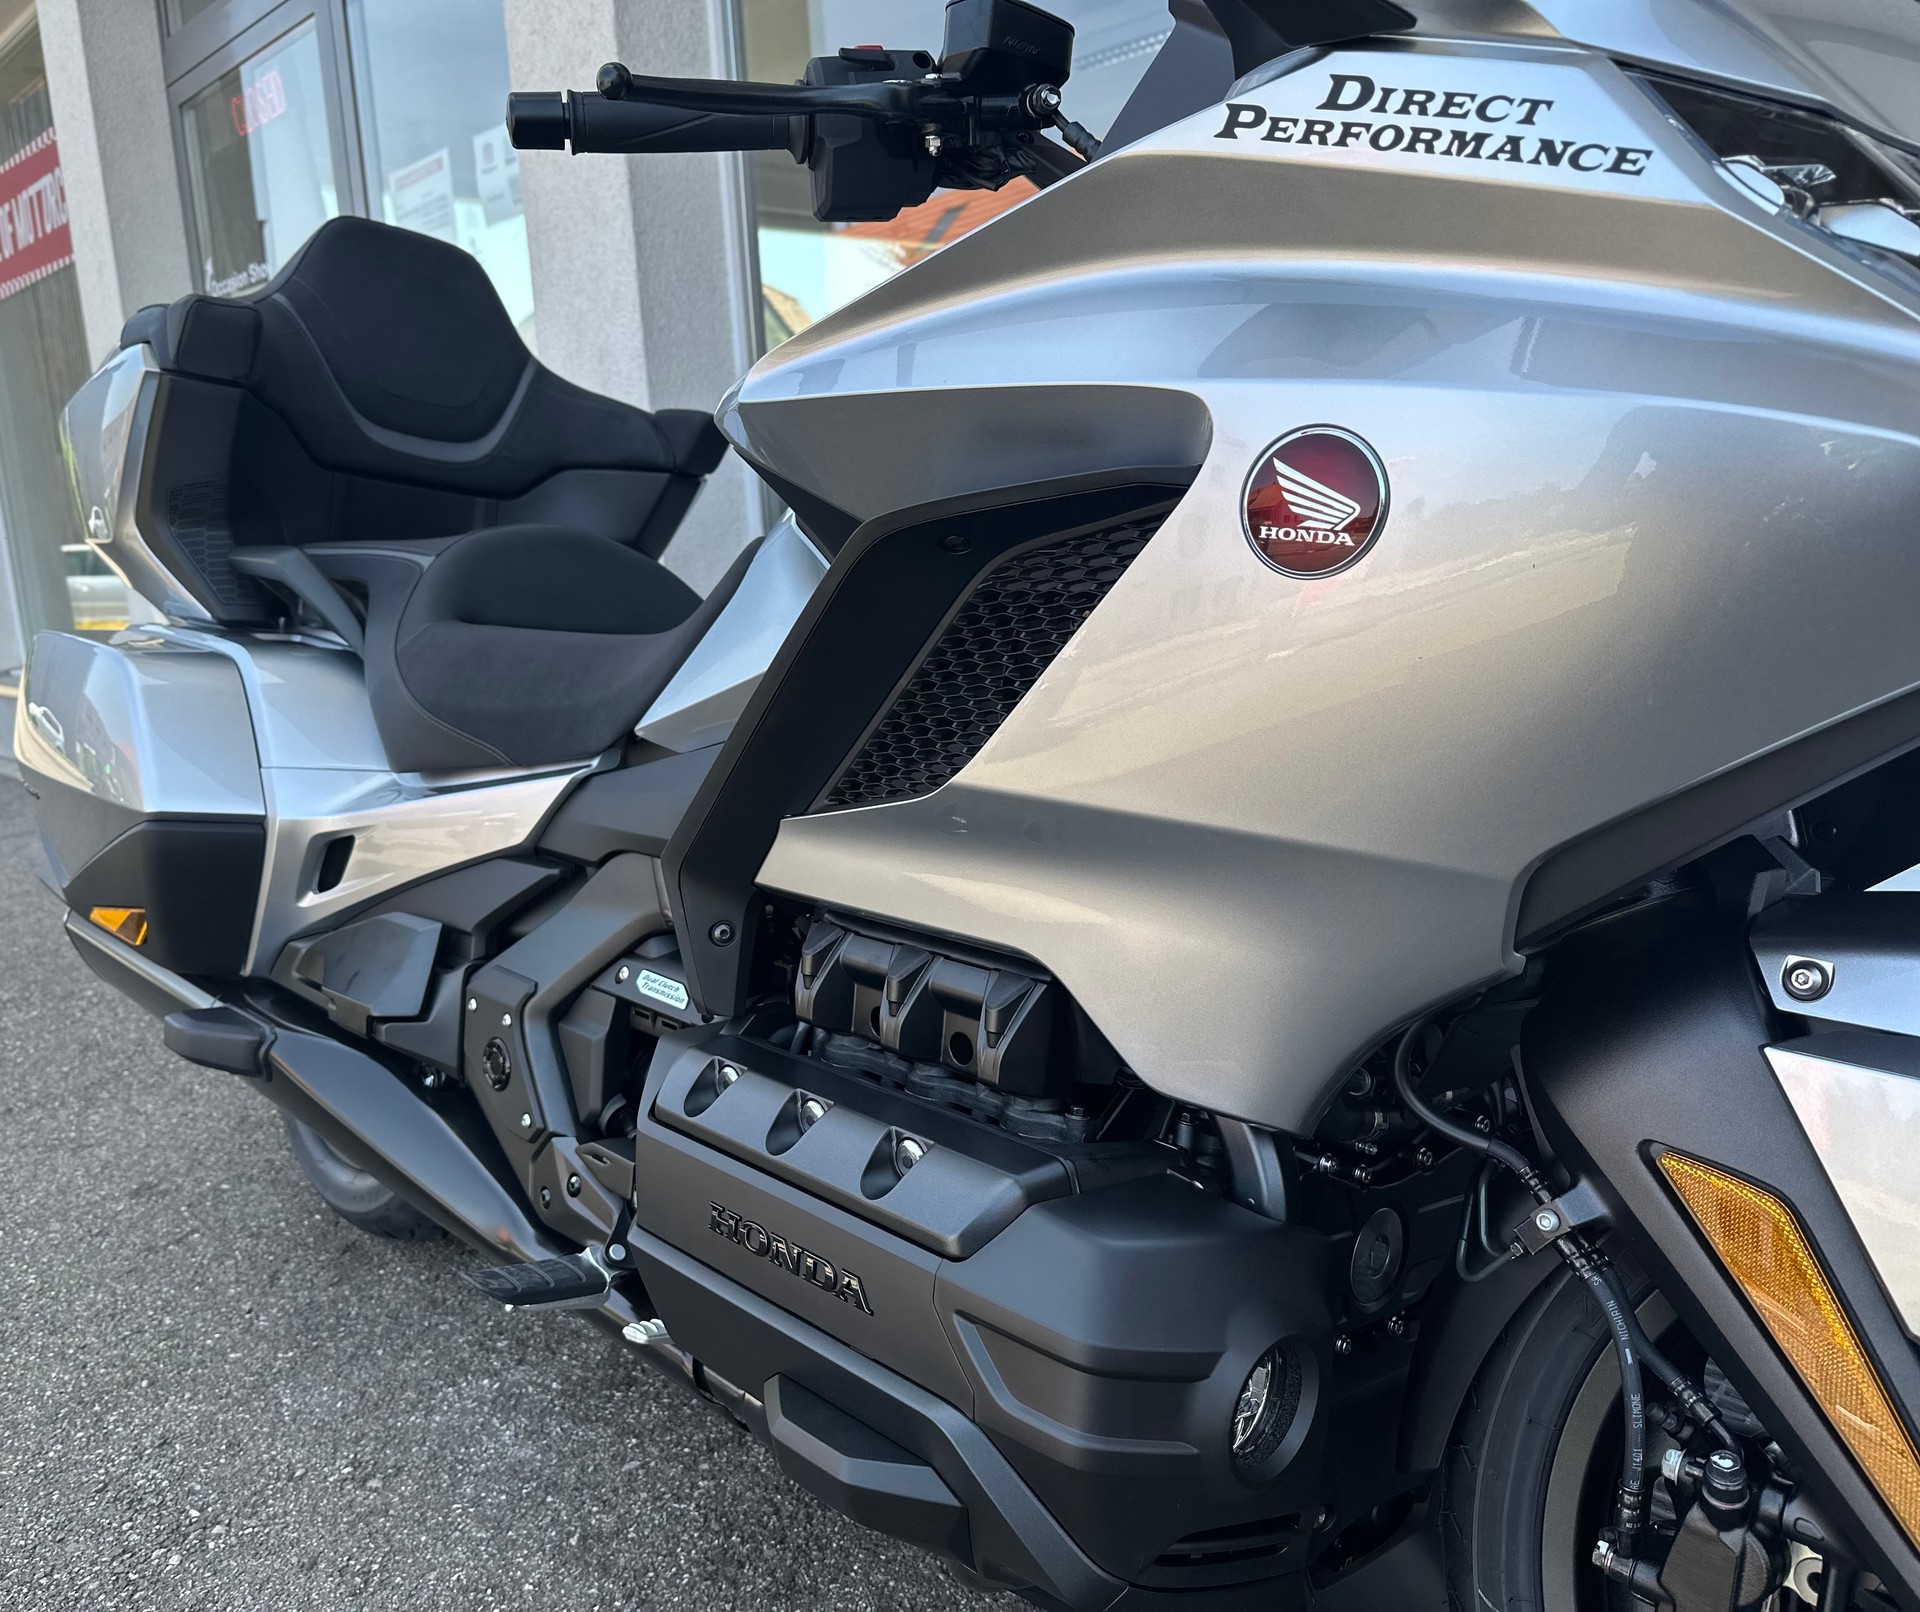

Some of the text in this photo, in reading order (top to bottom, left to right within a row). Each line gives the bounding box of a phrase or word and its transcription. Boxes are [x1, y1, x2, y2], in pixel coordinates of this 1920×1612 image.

[1315, 73, 1554, 126] DIRECT
[1214, 102, 1654, 176] PERFORMANCE
[1259, 525, 1356, 547] HONDA
[642, 974, 680, 993] Dual Clutch
[642, 982, 685, 1004] Transmission
[708, 1200, 874, 1317] HONDA
[1606, 1300, 1630, 1341] NICHIRIN
[1630, 1393, 1643, 1429] SLIMONE
